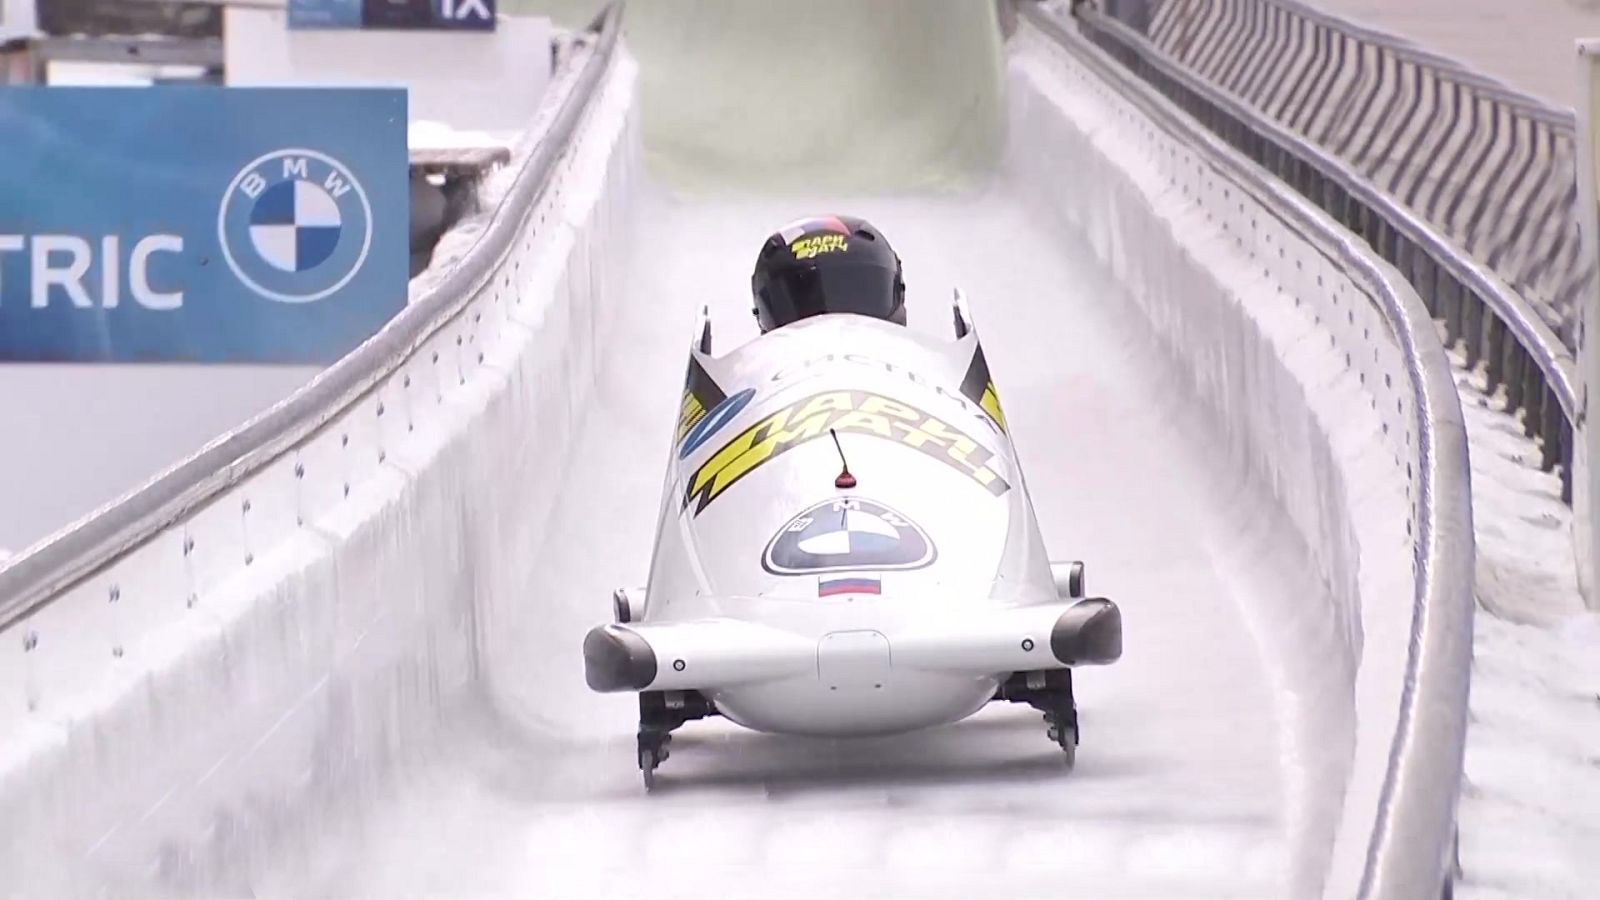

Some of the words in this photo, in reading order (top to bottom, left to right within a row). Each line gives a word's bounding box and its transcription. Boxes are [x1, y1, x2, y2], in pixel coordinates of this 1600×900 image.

[239, 158, 351, 199] BMW
[689, 390, 995, 498] ПАРИ
[707, 410, 997, 501] МАТЧ
